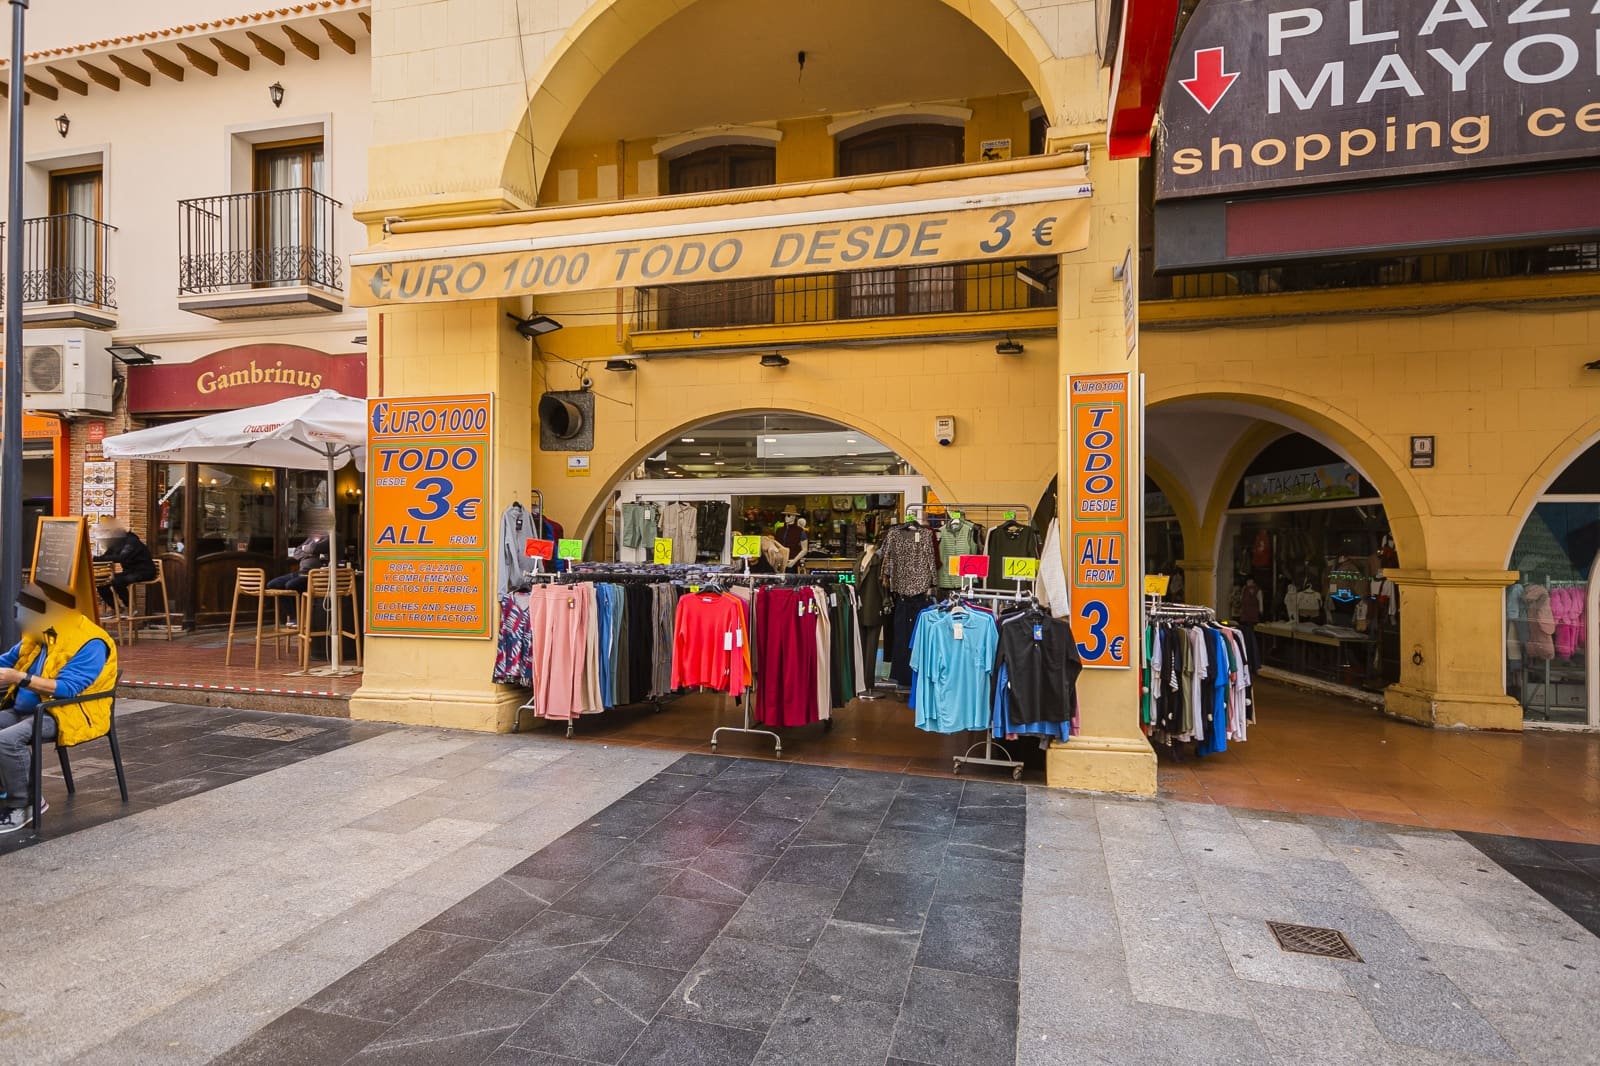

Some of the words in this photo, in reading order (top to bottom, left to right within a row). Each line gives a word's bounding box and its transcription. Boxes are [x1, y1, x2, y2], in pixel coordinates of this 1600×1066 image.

[1268, 0, 1600, 57] PLAZ
[1172, 115, 1491, 175] shopping
[504, 252, 590, 291] 1000
[615, 238, 743, 281] TODO
[771, 218, 948, 268] DESDE
[980, 209, 1016, 253] 3
[196, 360, 322, 394] Gambrinus
[380, 447, 478, 472] TODO
[376, 477, 406, 487] DESDE
[1081, 499, 1117, 512] DESDE
[376, 526, 434, 545] ALL
[449, 535, 478, 545] FROM
[1080, 538, 1119, 565] ALL
[418, 564, 464, 572] CALZADO
[392, 574, 469, 583] COMPLEMENTOS
[1085, 569, 1114, 582] FROM
[374, 584, 420, 593] DIRECTOS
[422, 585, 435, 593] DE
[438, 585, 478, 594] FABRICA
[377, 602, 419, 611] CLOTHES
[422, 603, 441, 611] AND
[444, 603, 476, 612] SHOES
[374, 612, 406, 621] DIRECT
[408, 613, 435, 622] FROM
[436, 614, 479, 623] FACTORY
